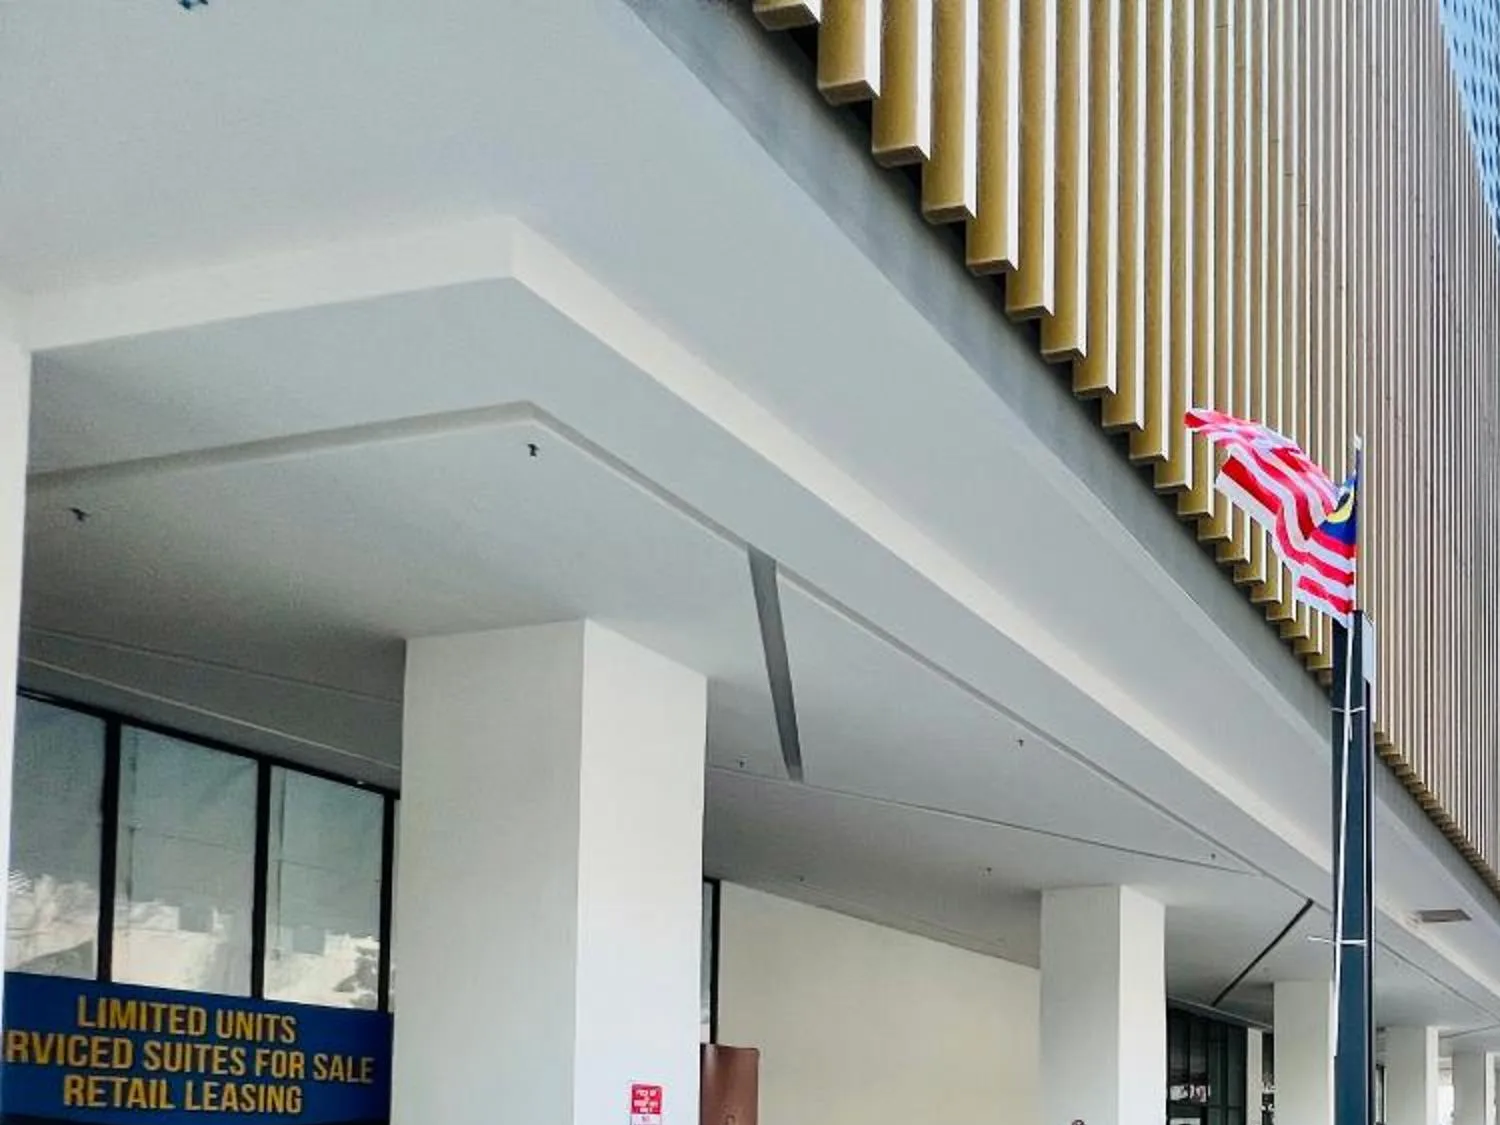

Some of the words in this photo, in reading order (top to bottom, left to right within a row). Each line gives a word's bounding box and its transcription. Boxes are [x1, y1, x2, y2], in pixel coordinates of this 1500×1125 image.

[77, 994, 207, 1035] LIMITED
[215, 1008, 297, 1043] UNITS
[143, 1040, 246, 1077] SUITES
[255, 1049, 305, 1079] FOR
[312, 1053, 375, 1084] SALE
[63, 1074, 175, 1110] RETAIL
[184, 1080, 302, 1114] LEASING
